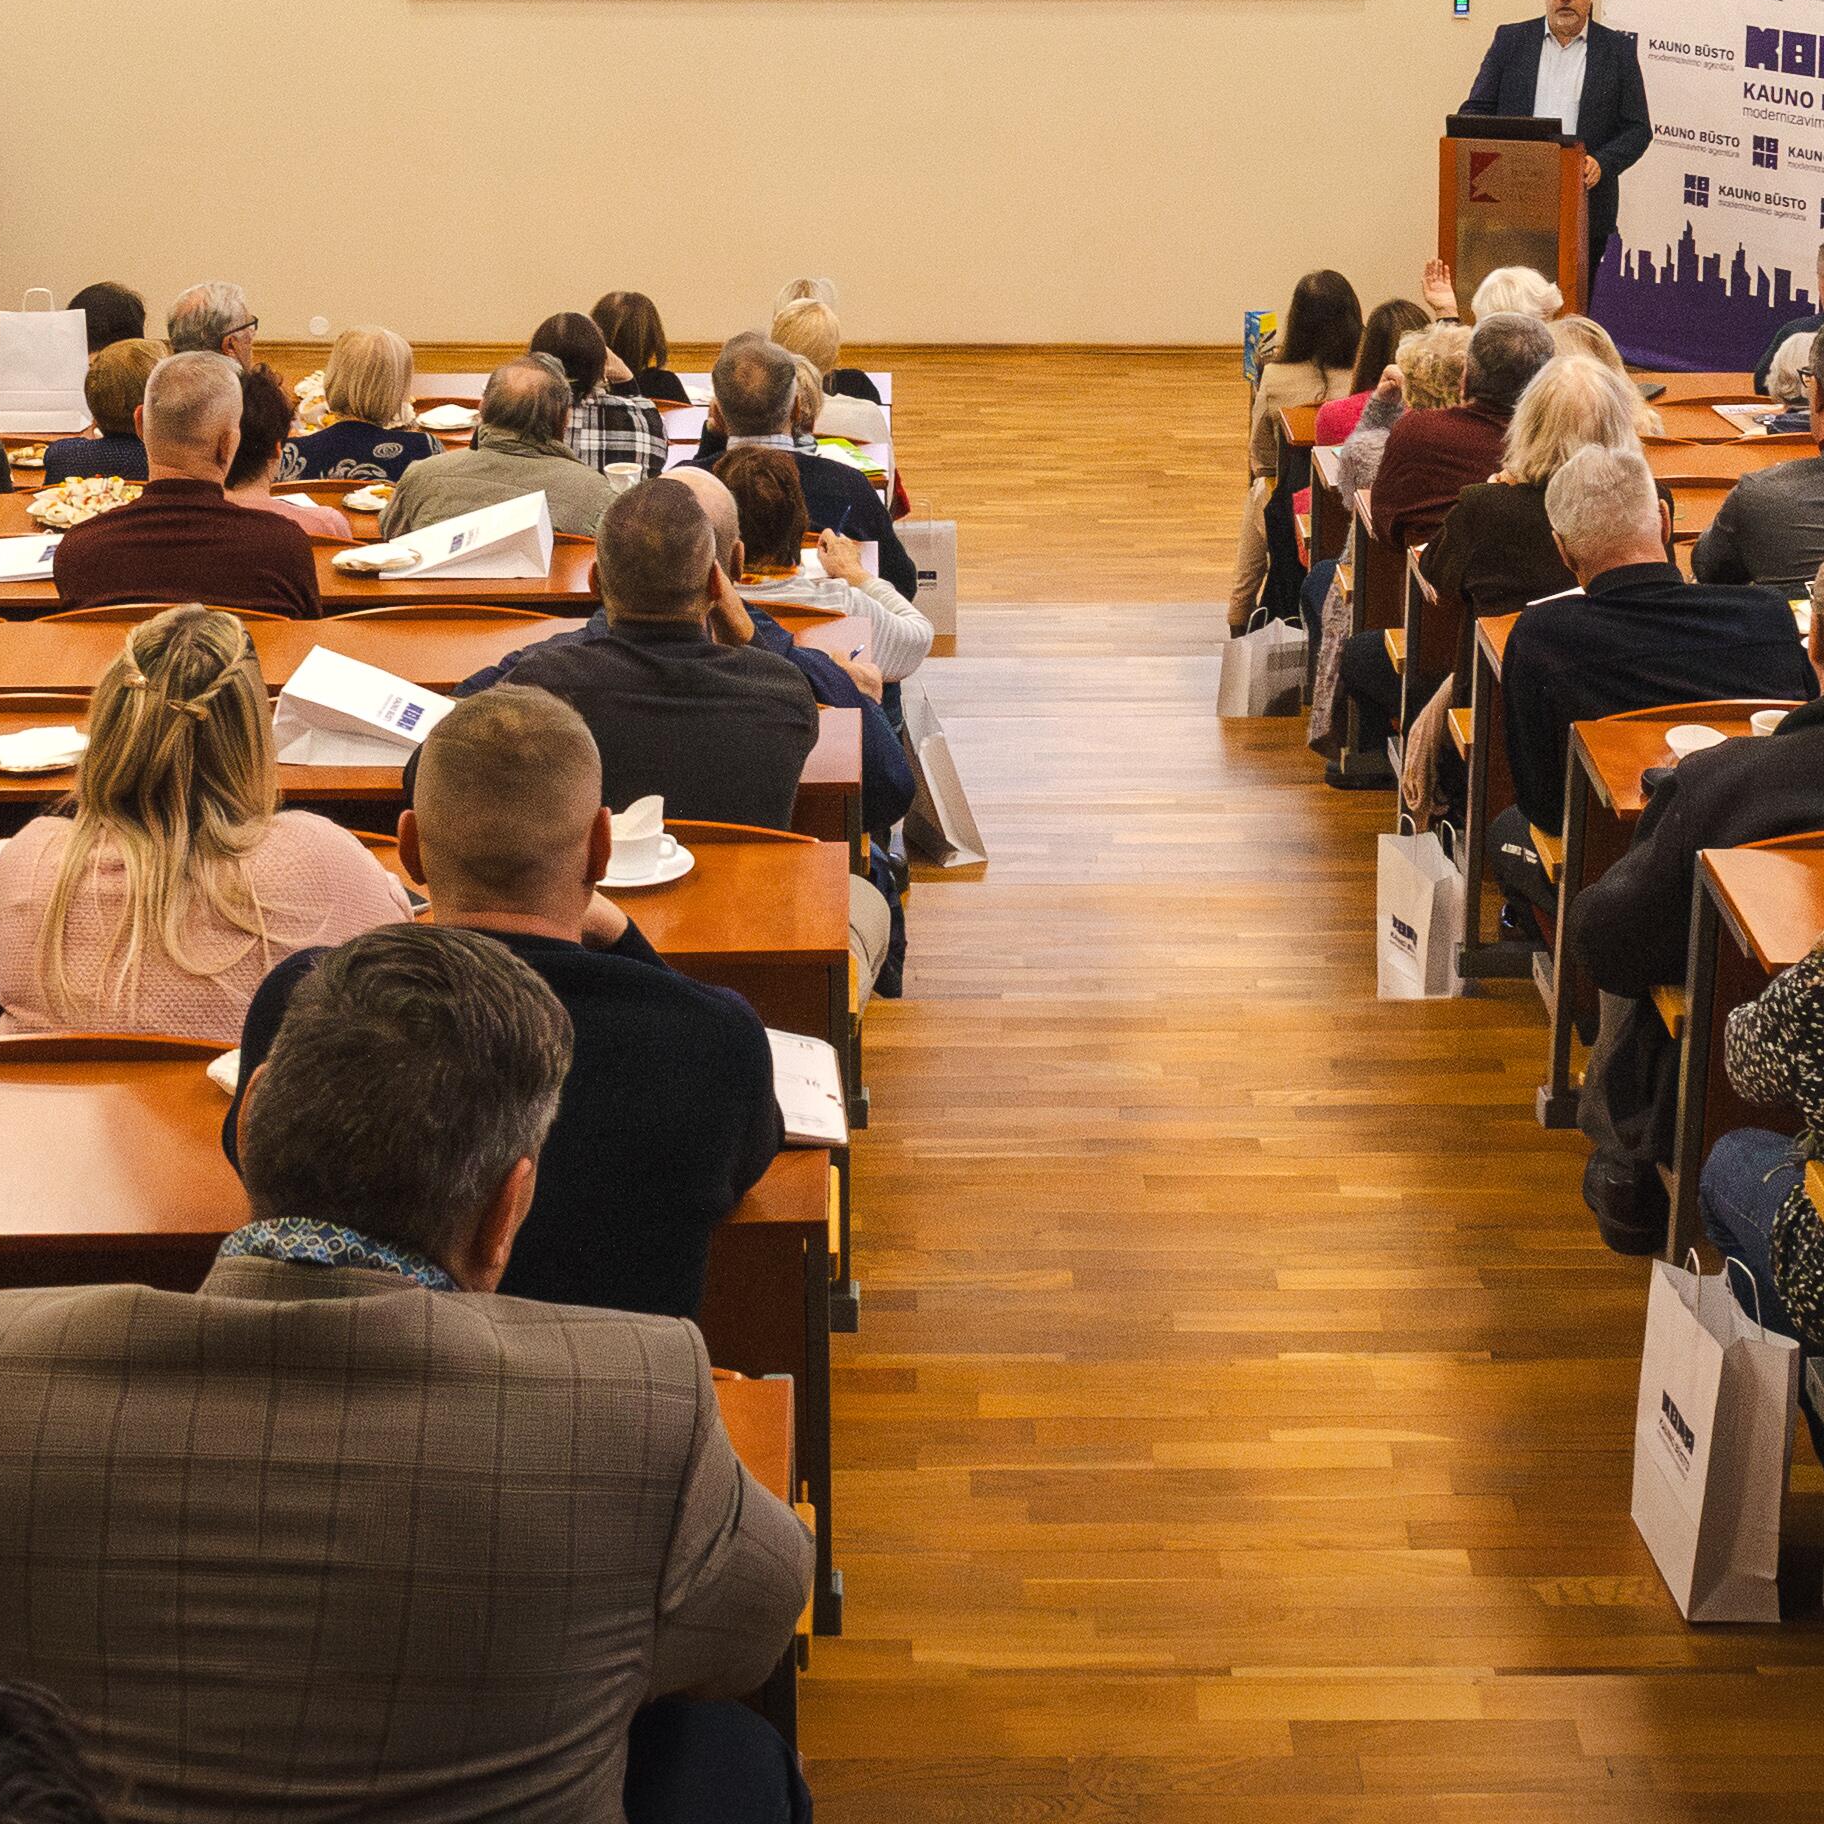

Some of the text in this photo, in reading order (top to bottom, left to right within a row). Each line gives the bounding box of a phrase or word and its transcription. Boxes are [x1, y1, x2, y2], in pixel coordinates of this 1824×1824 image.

[1649, 39, 1734, 61] KAUNO BŪSTO
[1743, 82, 1813, 108] KAUNO
[1654, 124, 1740, 147] KAUNO BŪSTO
[1718, 185, 1806, 210] KAUNO BŪSTO
